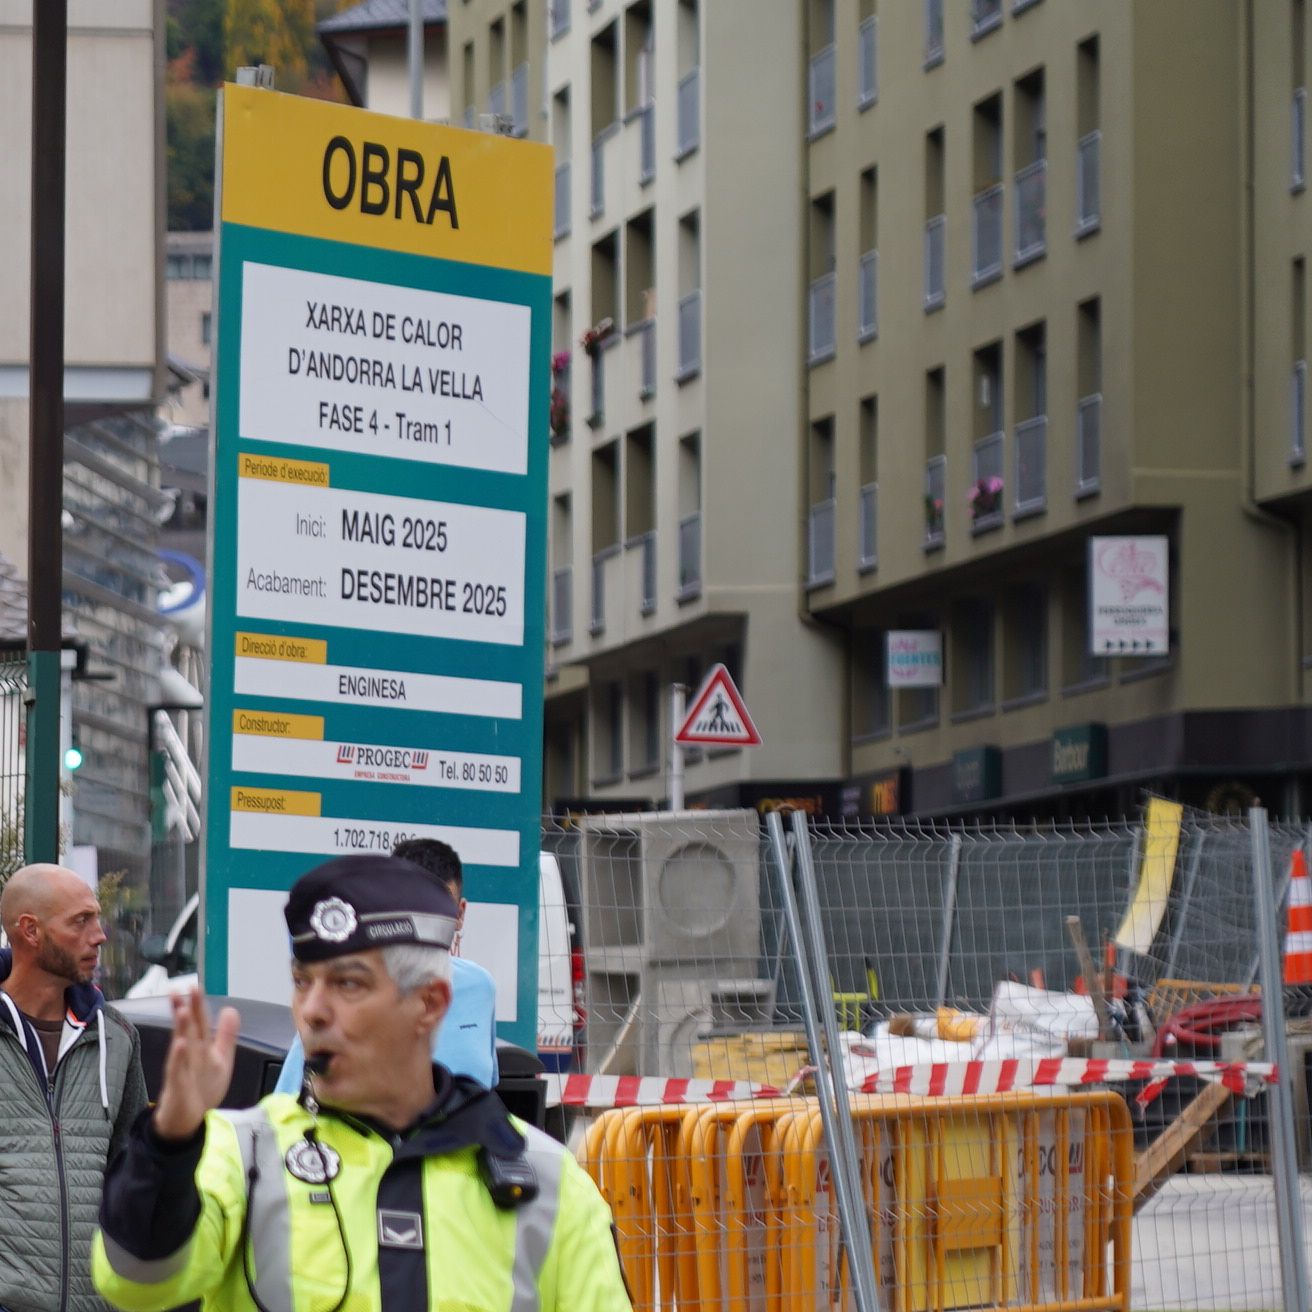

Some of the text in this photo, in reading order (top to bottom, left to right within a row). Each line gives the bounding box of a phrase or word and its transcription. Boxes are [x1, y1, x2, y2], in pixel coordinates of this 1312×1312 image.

[322, 134, 460, 230] OBRA
[306, 300, 463, 351] XARXA DE CALOR
[288, 347, 484, 402] D'ANDORRA LA VELLA
[319, 401, 365, 434] FASE
[369, 409, 378, 435] 4
[395, 412, 439, 444] Tram
[444, 418, 453, 446] 1
[296, 509, 448, 553] Inici: MAIG 2025
[246, 568, 507, 617] Acabament: DESEMBRE 2025
[338, 674, 407, 701] ENGINESA
[239, 714, 290, 735] Constructor:
[356, 746, 412, 770] PROGEC
[439, 759, 508, 785] Tel. 80 50 50
